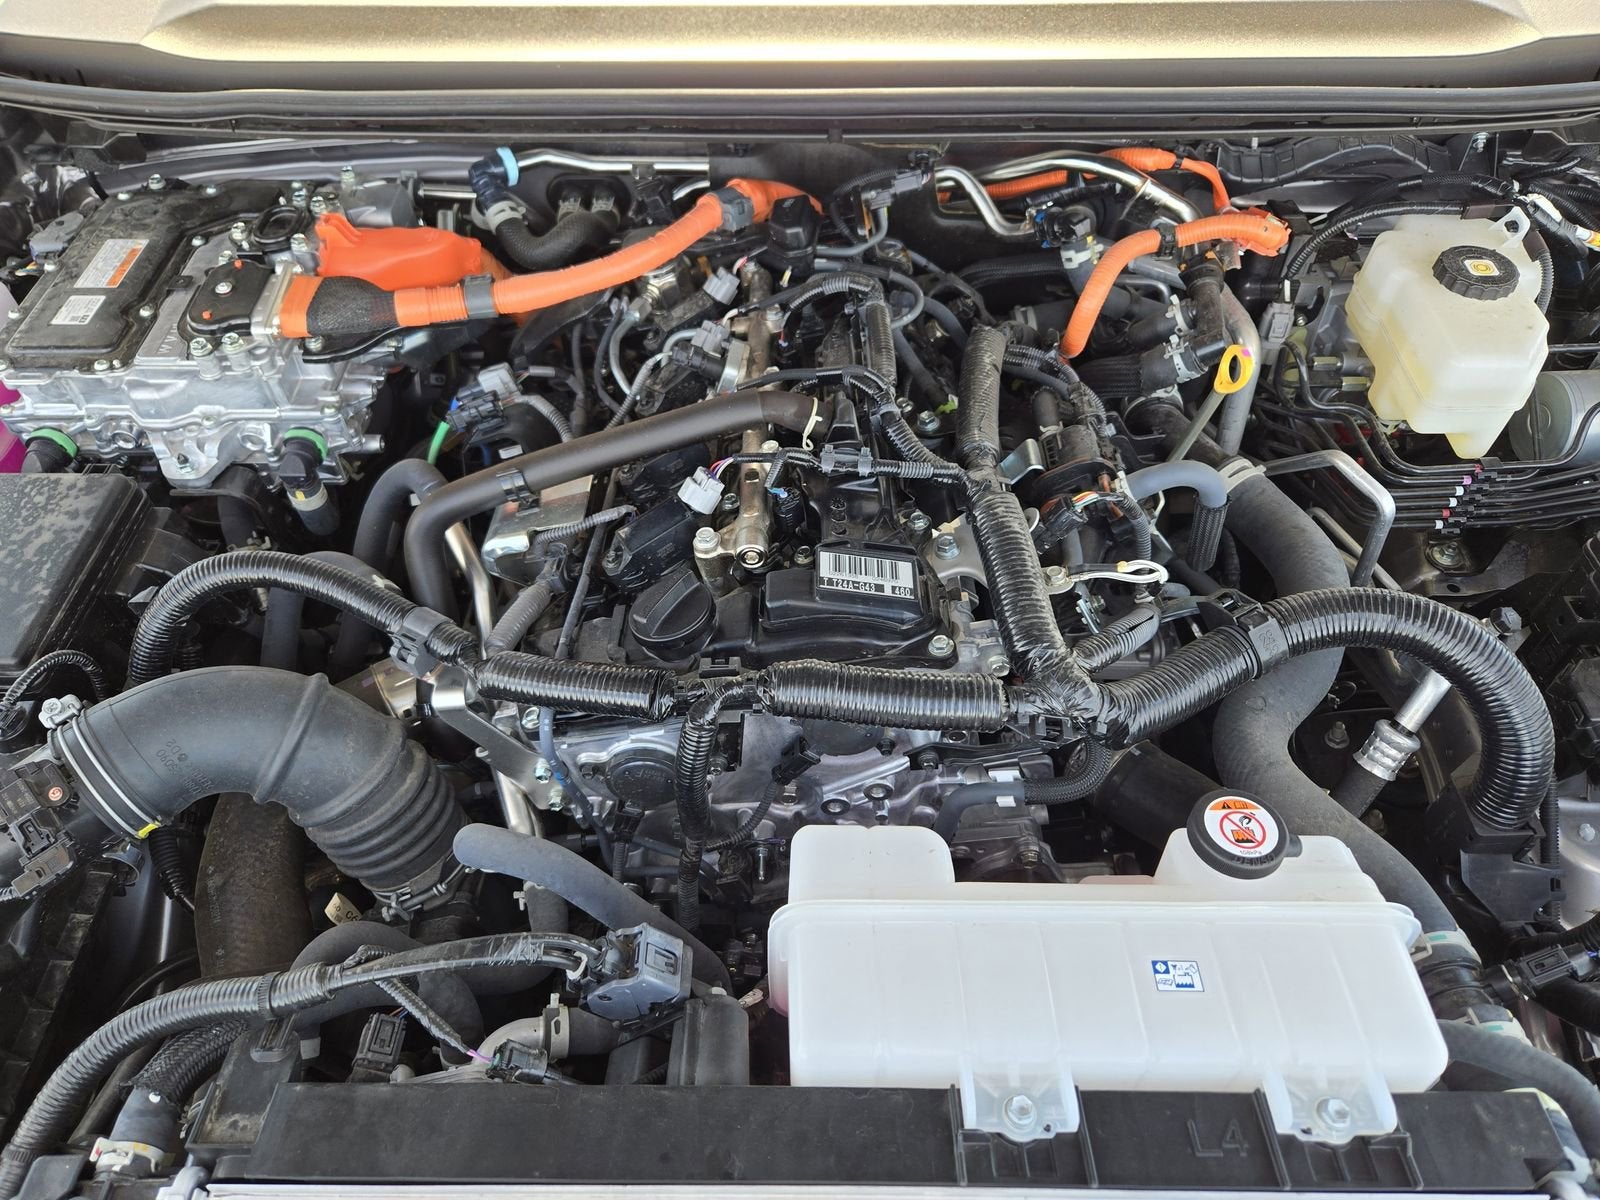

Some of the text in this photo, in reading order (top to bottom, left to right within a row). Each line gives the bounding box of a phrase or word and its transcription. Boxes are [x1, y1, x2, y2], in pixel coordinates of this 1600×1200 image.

[832, 579, 876, 593] T24A-G43
[894, 586, 911, 597] 460
[1186, 1118, 1249, 1157] L4
